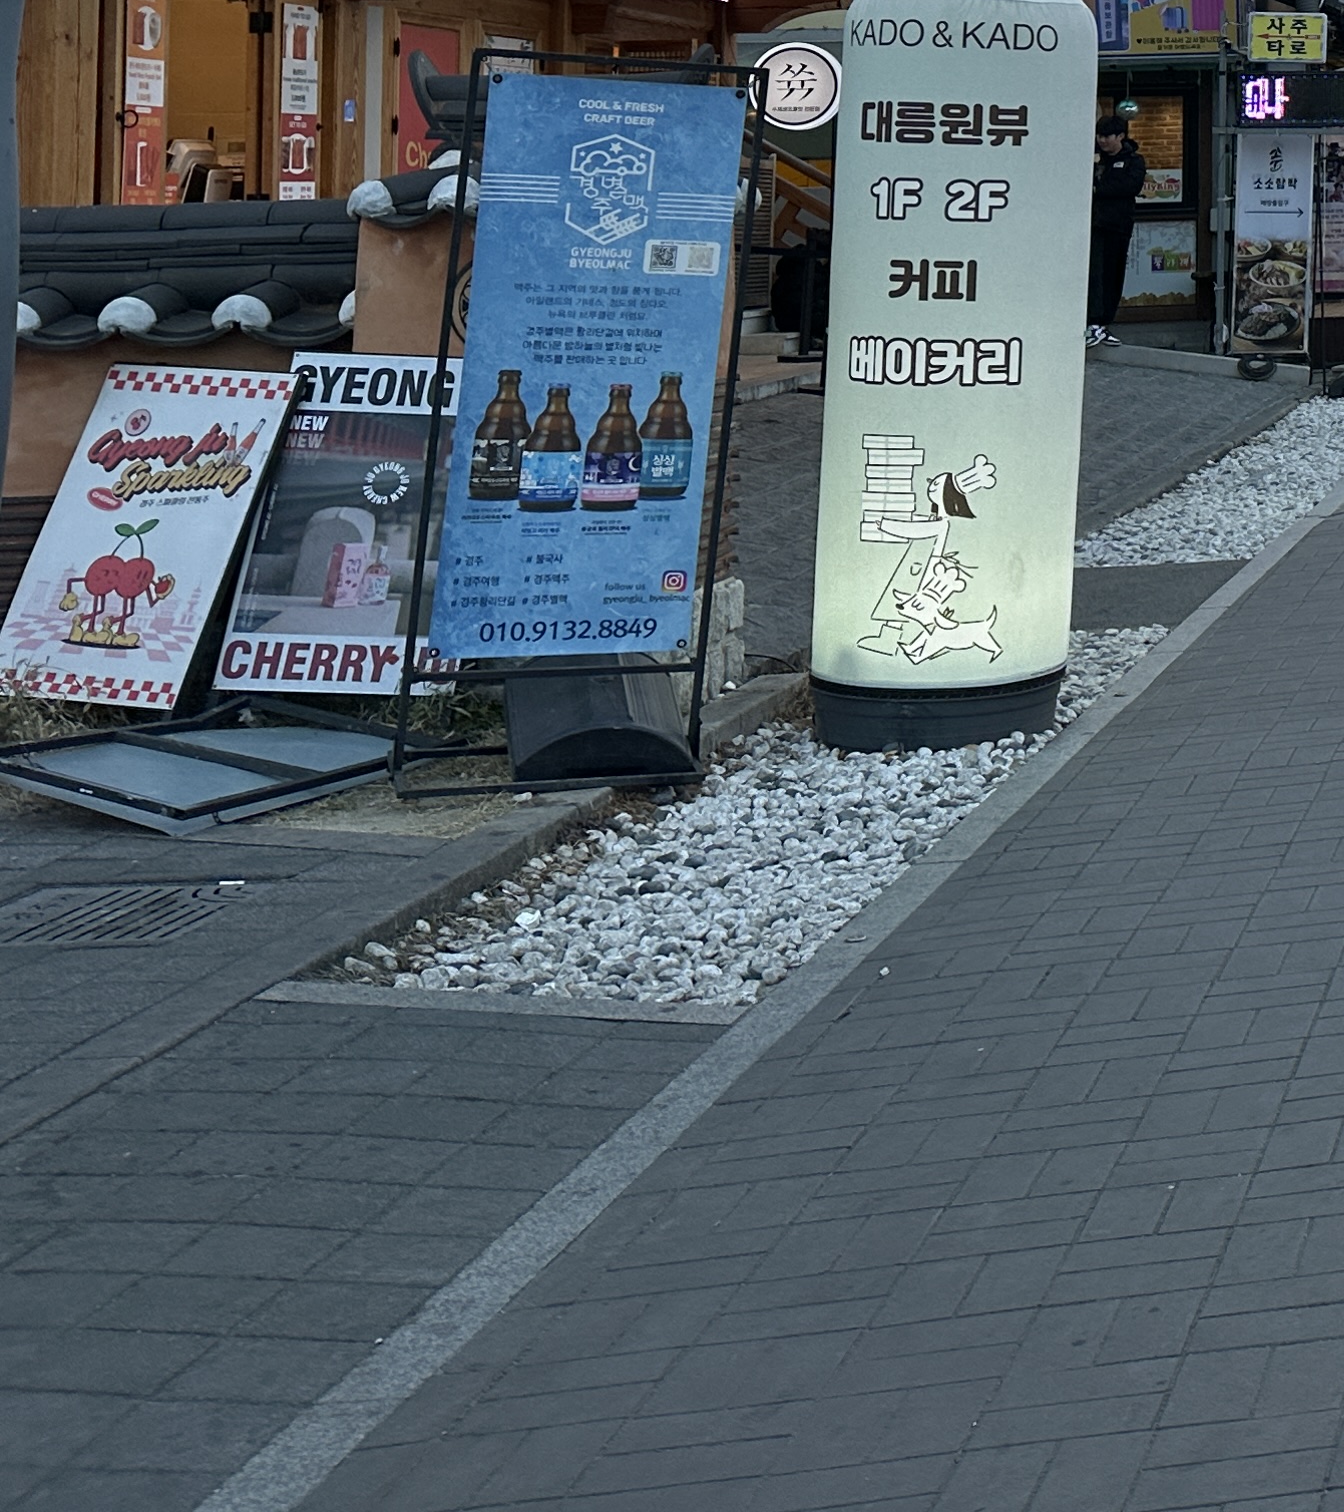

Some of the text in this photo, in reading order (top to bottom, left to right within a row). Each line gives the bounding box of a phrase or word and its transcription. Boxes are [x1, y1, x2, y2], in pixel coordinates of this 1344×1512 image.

[1266, 18, 1308, 35] 사주
[850, 18, 1059, 52] KADO & KADO
[1266, 39, 1307, 56] 타로
[578, 99, 664, 113] COOL & FRESH
[583, 114, 656, 126] CRAFT BEER
[861, 100, 1029, 147] 대릉원뷰
[870, 177, 1010, 221] 1F 2F
[571, 247, 632, 259] GYEONGJU
[569, 258, 632, 271] BYEOLMAC
[888, 259, 978, 302] 커피
[848, 335, 1023, 387] 베이커리
[294, 364, 455, 408] GYEONG
[290, 415, 329, 431] NEW
[285, 433, 325, 449] NEW
[652, 454, 676, 466] 싱싱
[112, 456, 252, 502] Sparkling
[465, 555, 484, 566] 경주
[536, 553, 564, 565] 불국사
[463, 575, 500, 587] 경주여행
[534, 573, 570, 586] 경주맥주
[604, 581, 646, 592] follow us
[460, 596, 516, 608] 경주황리단길
[531, 594, 568, 606] 경주별맥
[479, 618, 658, 643] 010.9132.8849
[221, 639, 396, 683] CHERRY
